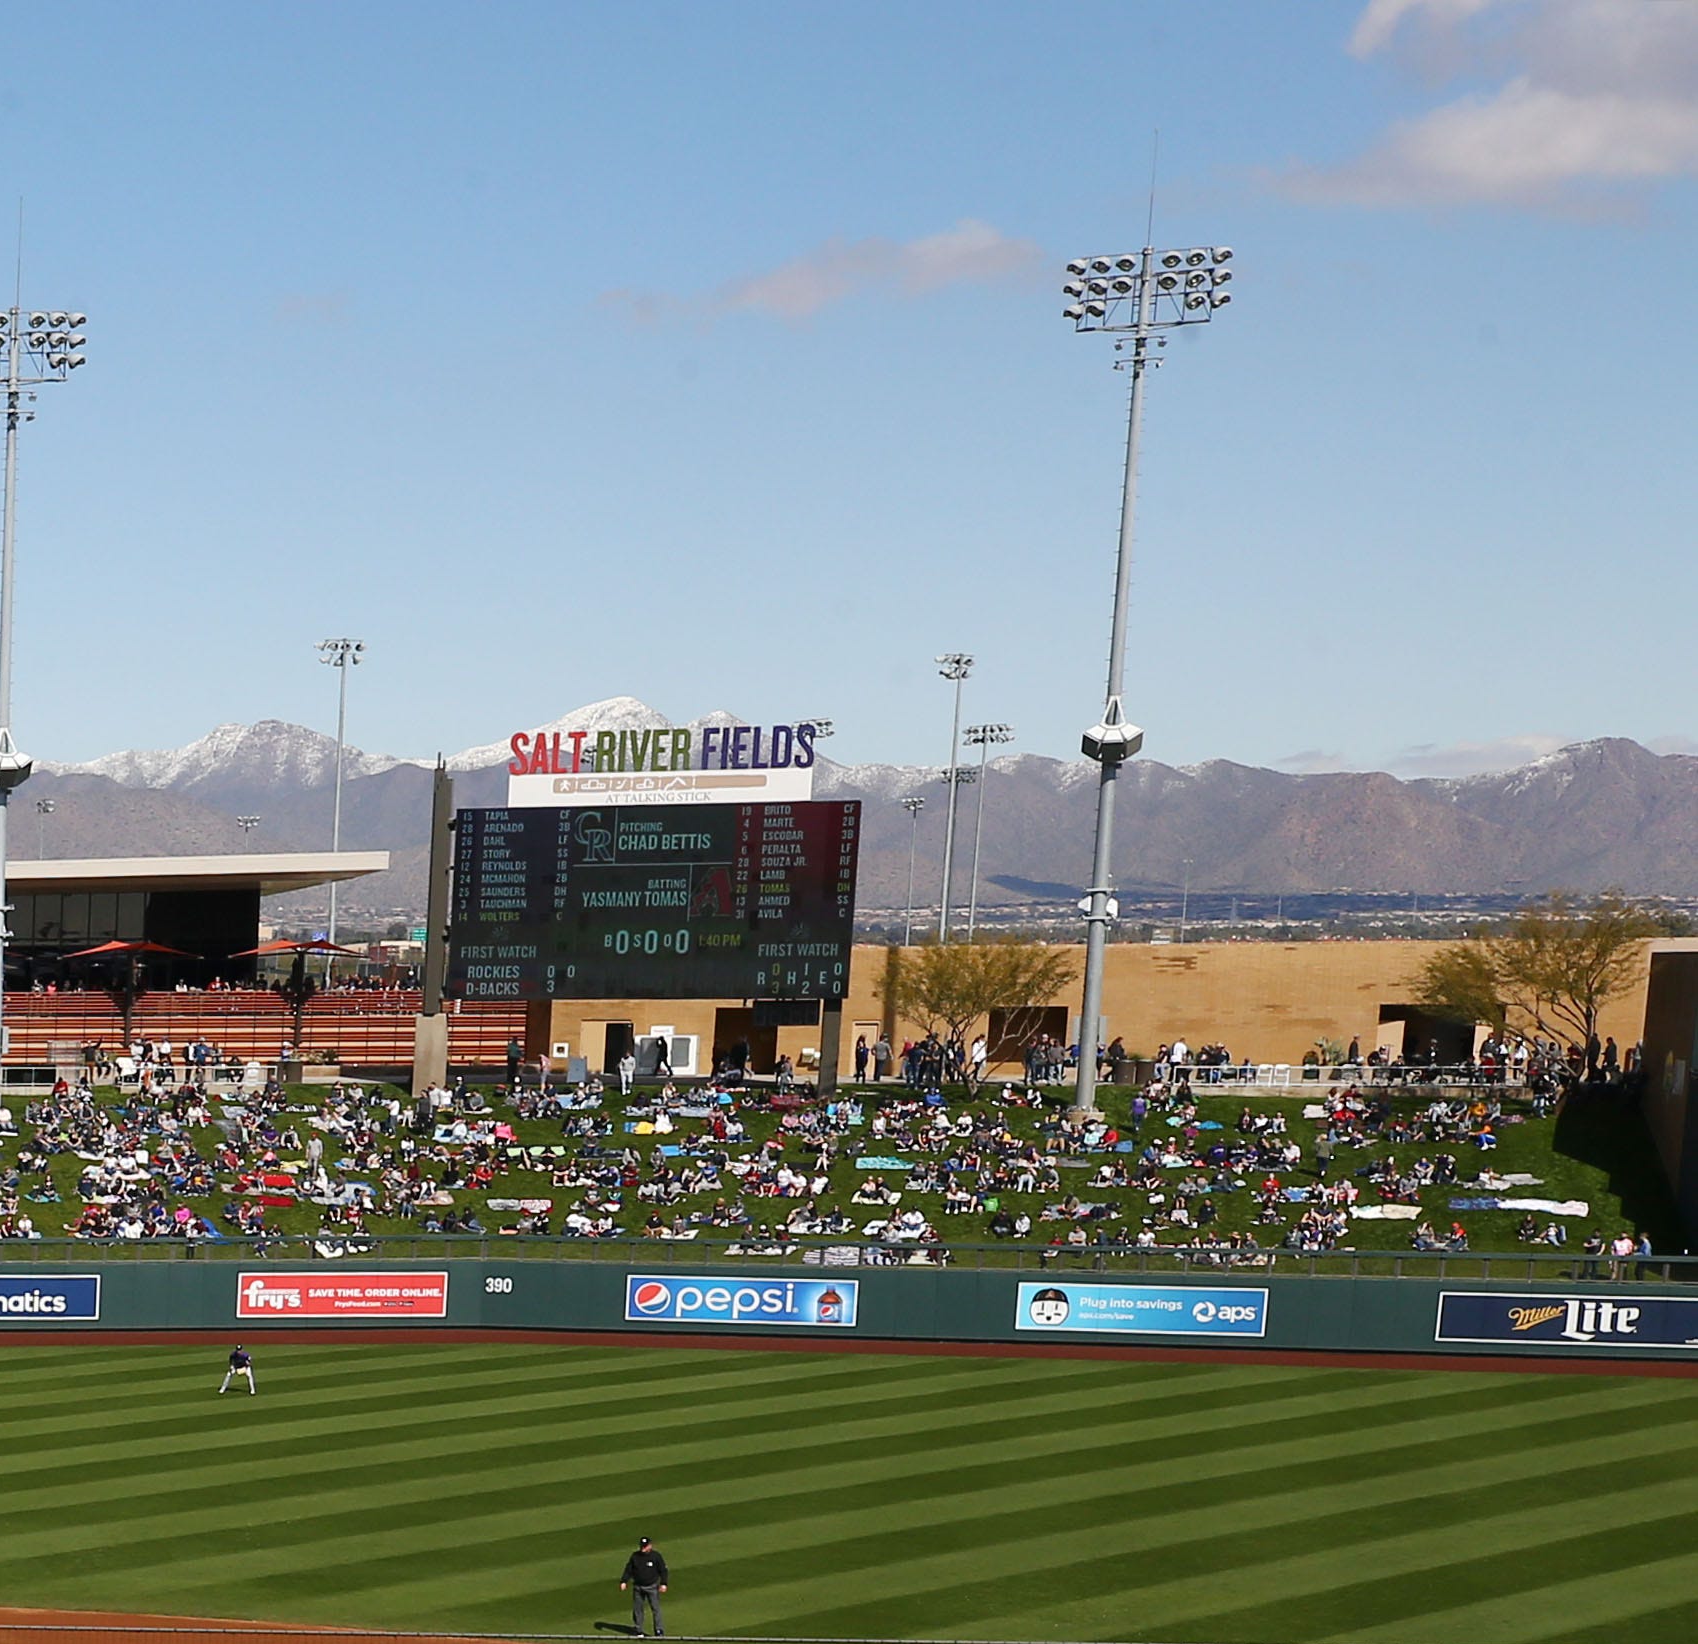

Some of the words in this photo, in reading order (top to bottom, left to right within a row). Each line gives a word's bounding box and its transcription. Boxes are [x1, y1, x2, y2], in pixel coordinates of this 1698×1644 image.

[509, 731, 587, 775] SALT
[595, 729, 691, 773] RIVER
[701, 724, 816, 769] FIELDS
[623, 792, 675, 802] TALKING
[677, 792, 712, 801] STICK
[620, 822, 663, 832] PITCHING
[618, 835, 657, 850] CHAD
[661, 833, 711, 849] BETTIS
[647, 879, 686, 889] BATTING
[582, 892, 642, 908] YASMANY
[644, 891, 687, 906] TOMAS
[604, 934, 612, 948] B
[633, 934, 641, 948] S
[722, 934, 741, 947] PM
[460, 945, 494, 959] FIRST
[497, 945, 537, 958] WATCH
[758, 944, 792, 957] FIRST
[797, 943, 838, 956] WATCH
[467, 965, 520, 979] ROCKIES
[757, 972, 765, 985] R
[787, 971, 796, 985] H
[819, 971, 827, 984] E
[466, 982, 519, 996] D-BACKS
[546, 980, 555, 993] 3
[802, 981, 810, 994] 2
[485, 1277, 513, 1294] 390
[243, 1280, 301, 1310] fry's
[308, 1288, 334, 1298] SAVE
[336, 1288, 363, 1297] TIME.
[365, 1288, 400, 1297] ORDER
[401, 1288, 442, 1298] ONLINE.
[676, 1283, 794, 1319] pepsi
[1079, 1297, 1106, 1309] Plug
[1110, 1298, 1133, 1309] into
[1136, 1300, 1183, 1312] savings
[1218, 1305, 1256, 1323] aps
[1508, 1304, 1566, 1330] Miller
[1561, 1301, 1641, 1341] Lite
